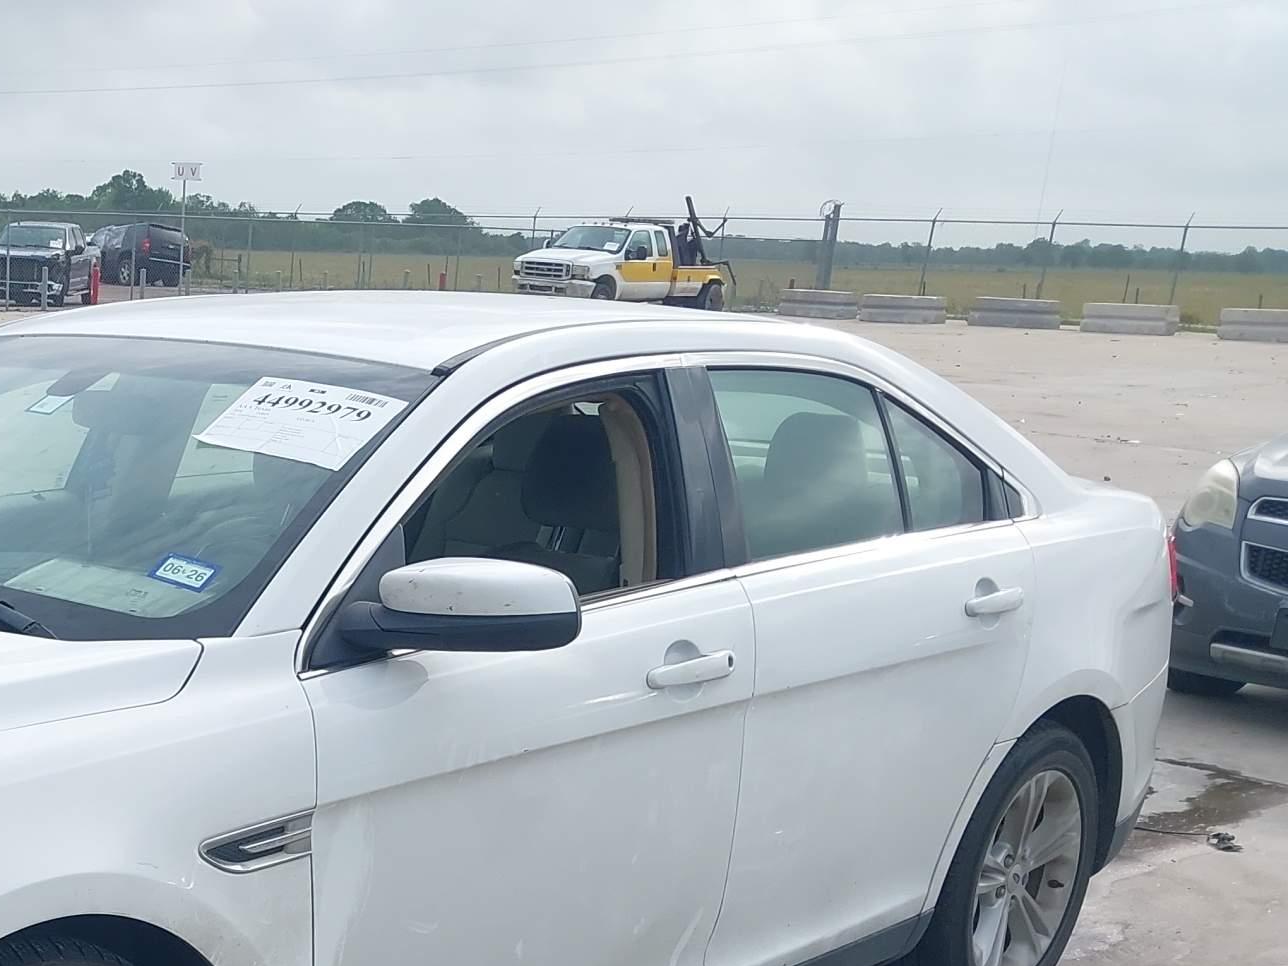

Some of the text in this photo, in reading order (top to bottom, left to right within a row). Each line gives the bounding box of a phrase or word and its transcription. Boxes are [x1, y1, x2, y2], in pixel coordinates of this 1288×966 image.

[177, 166, 197, 177] U V
[252, 392, 372, 422] 44992979
[162, 562, 208, 582] 06 26
